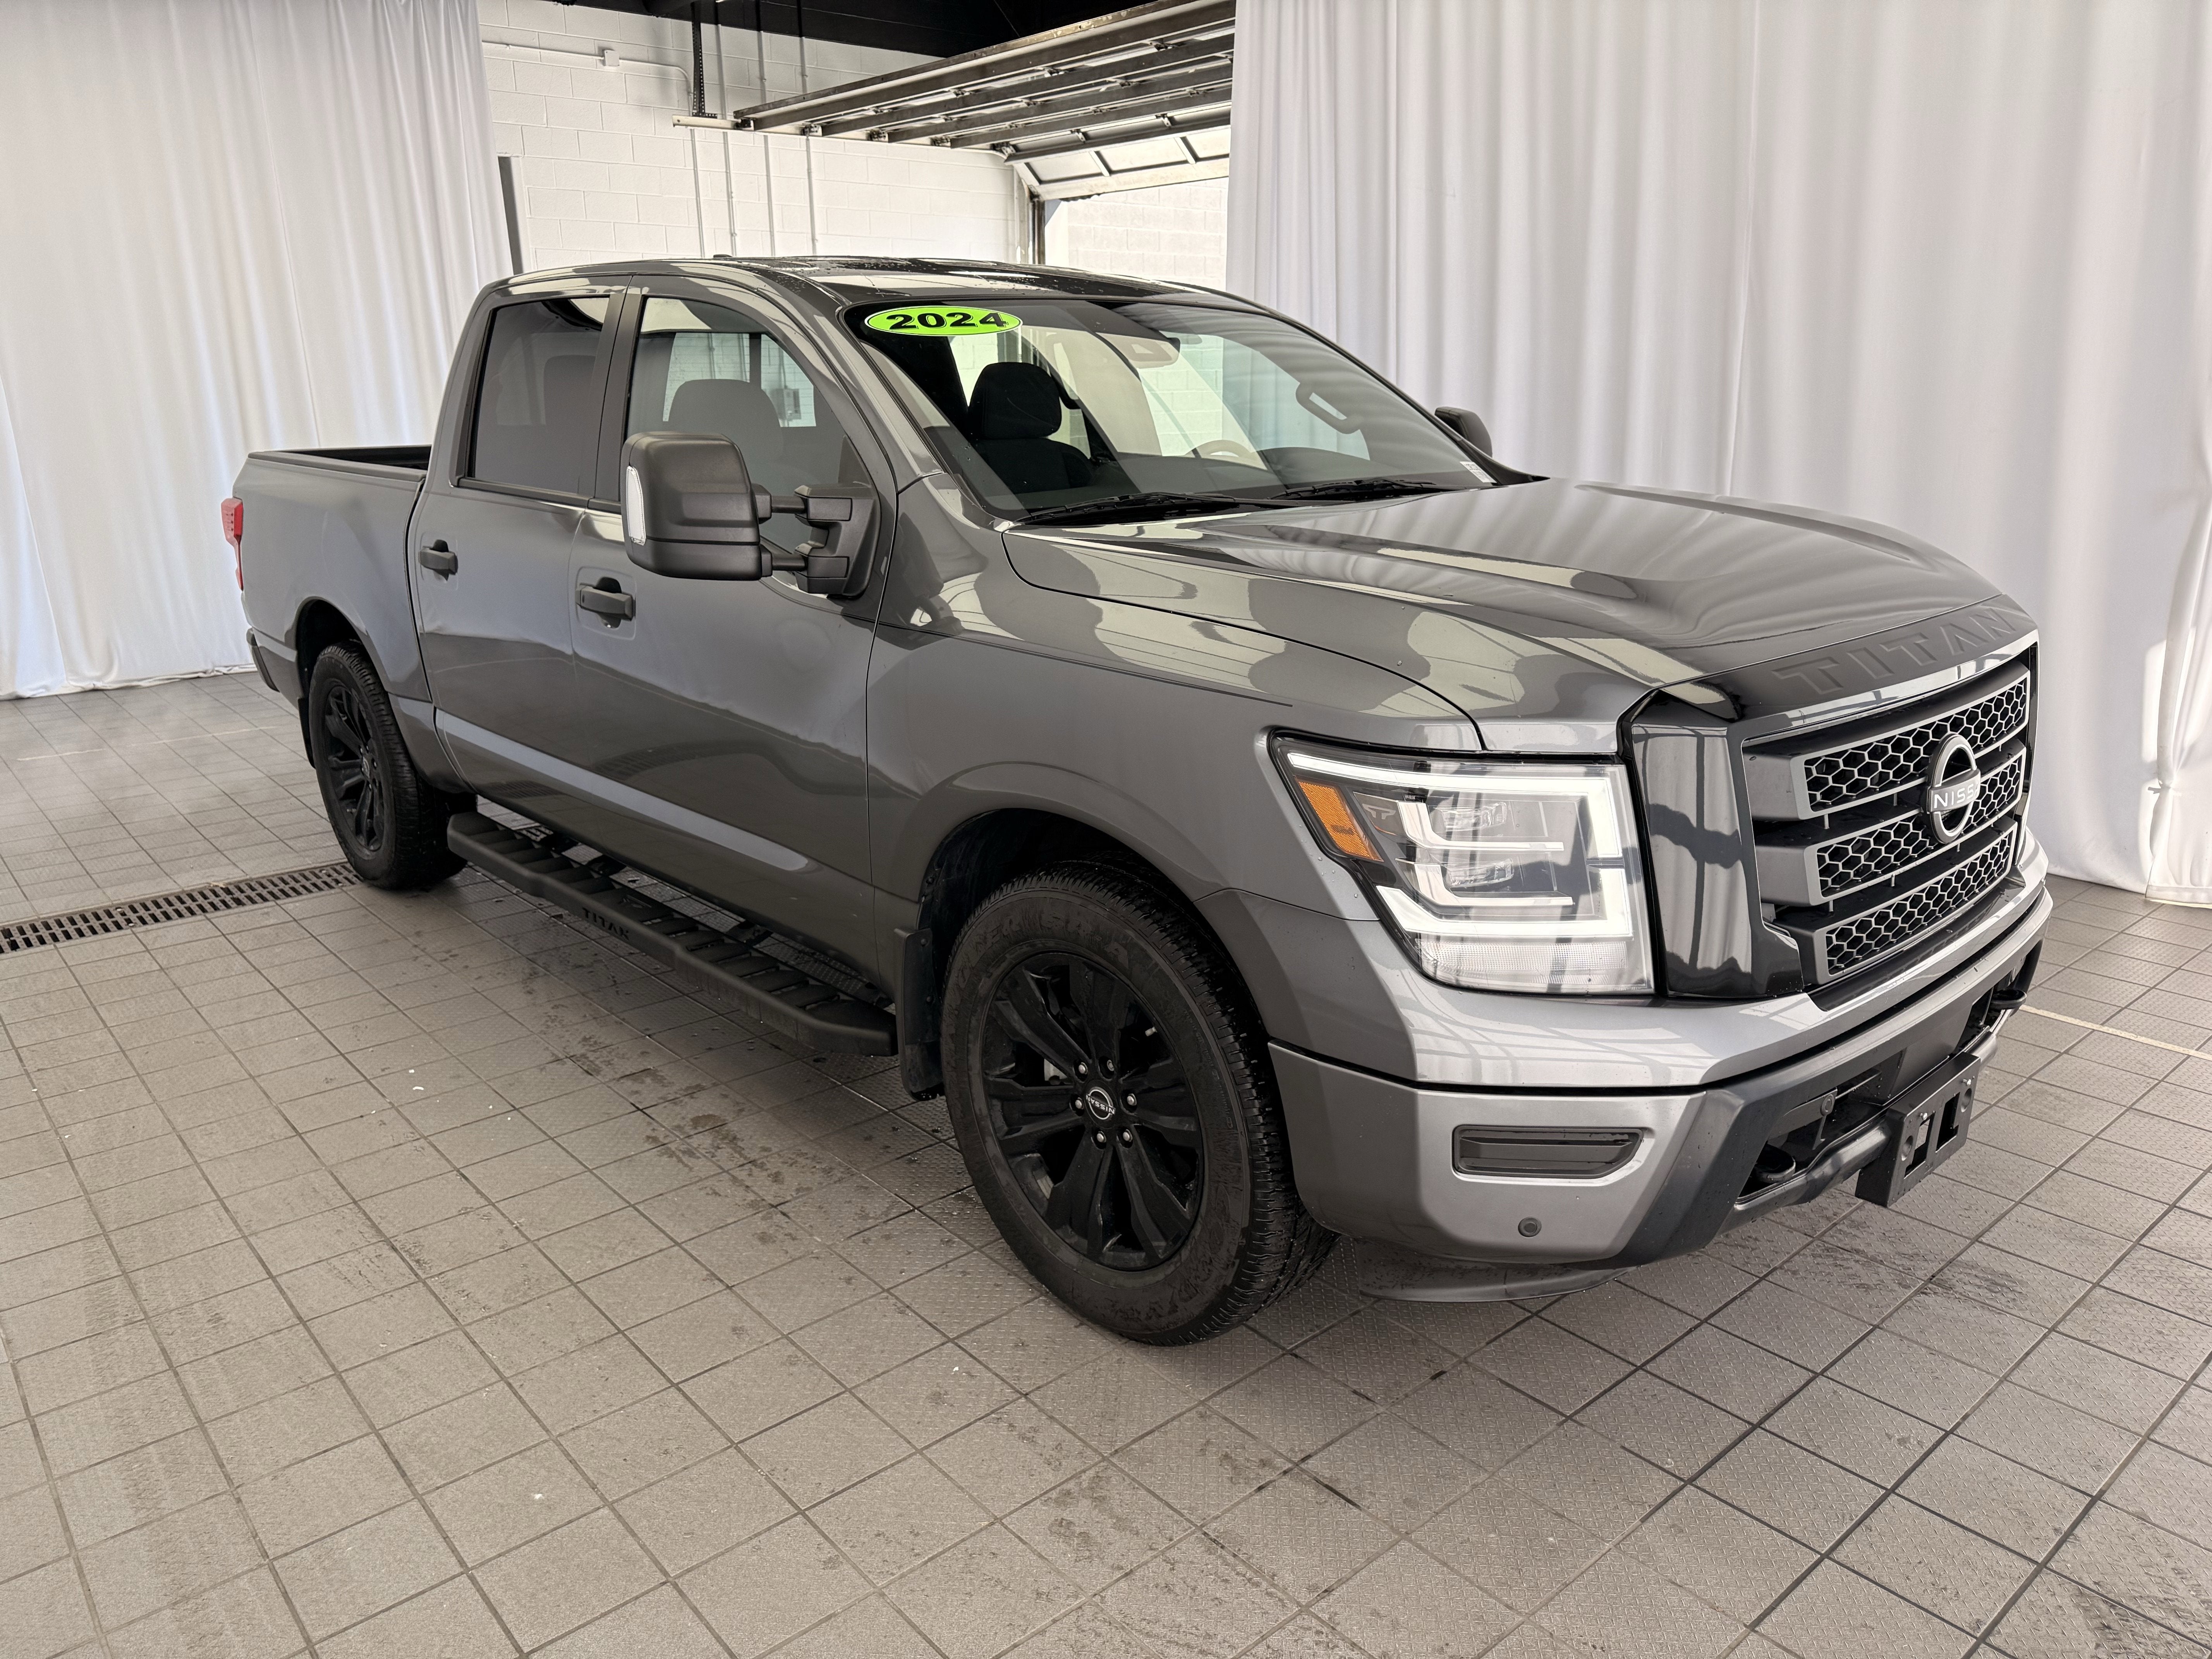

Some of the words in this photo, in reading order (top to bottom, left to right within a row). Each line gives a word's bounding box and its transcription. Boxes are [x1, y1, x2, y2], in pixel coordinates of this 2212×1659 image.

[886, 312, 1008, 330] 2024
[1772, 609, 2016, 694] TITAN
[582, 907, 629, 940] TITAN
[1086, 1095, 1115, 1115] NISSAN
